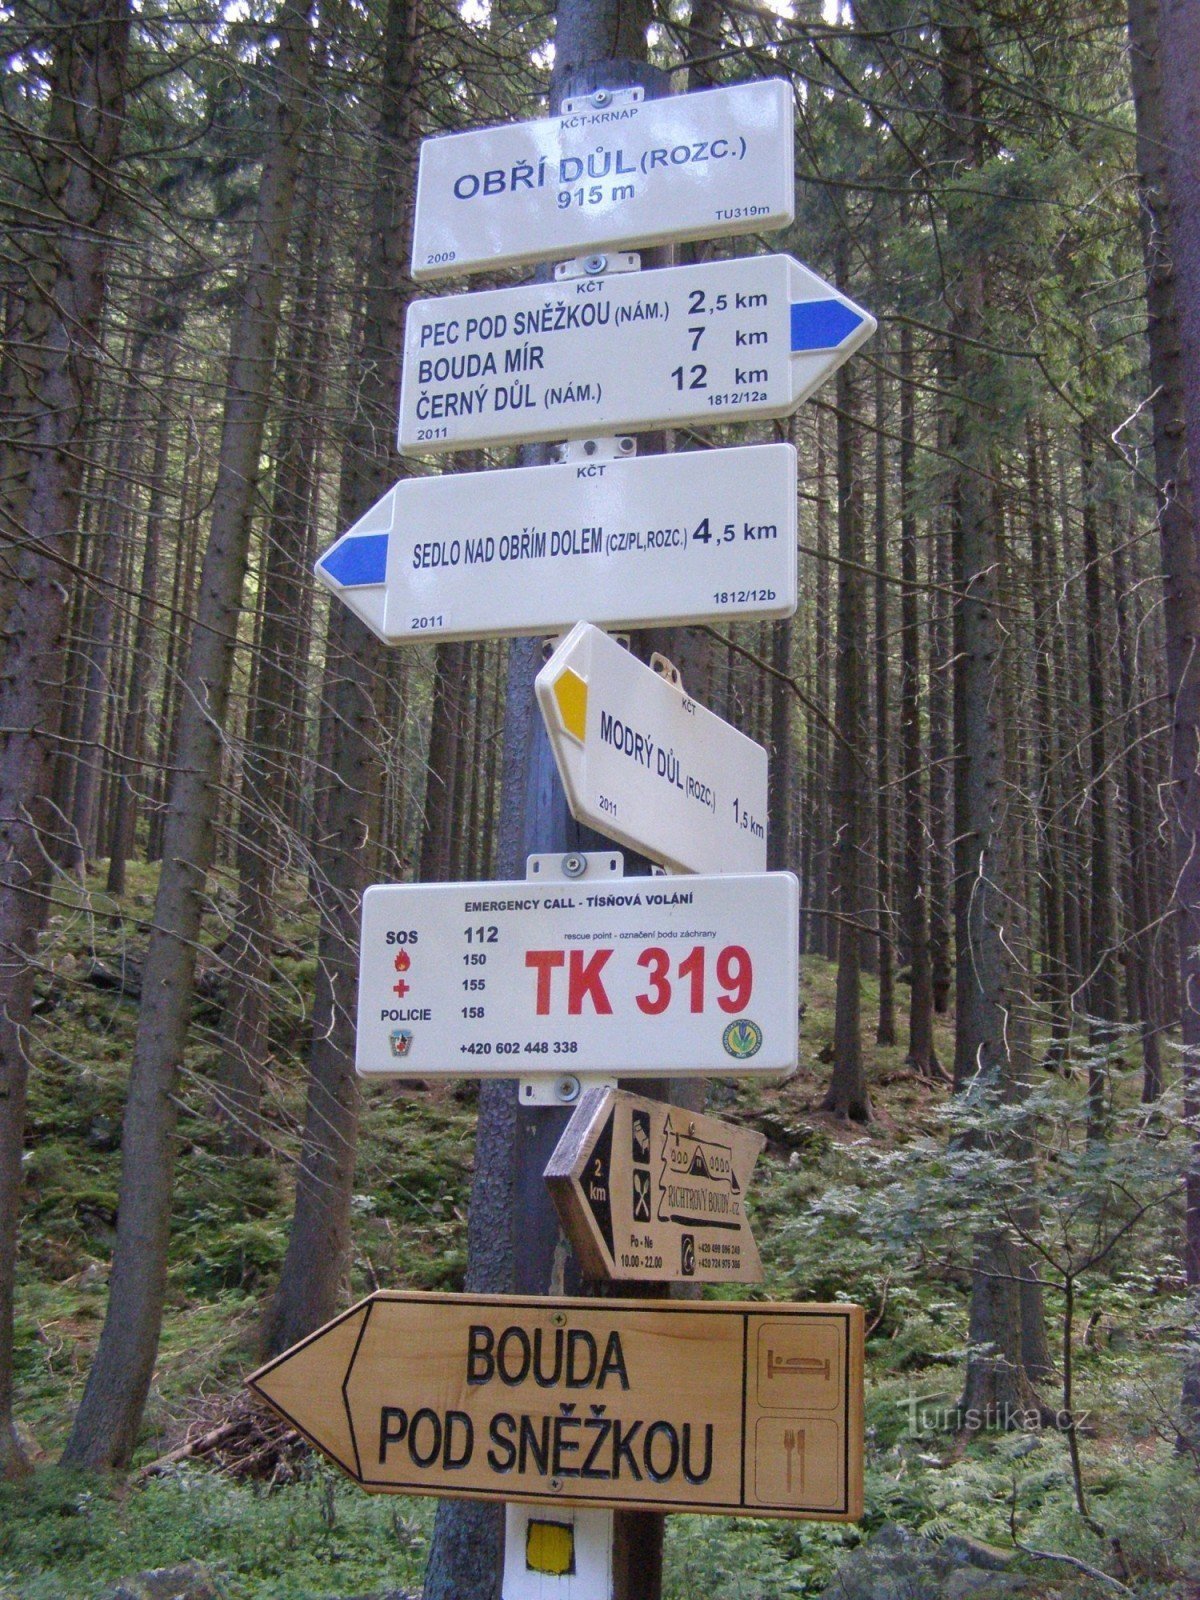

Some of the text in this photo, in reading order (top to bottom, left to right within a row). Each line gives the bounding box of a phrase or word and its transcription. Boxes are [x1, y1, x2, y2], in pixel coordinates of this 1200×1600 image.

[560, 108, 638, 129] KČT-KRNAP
[453, 136, 747, 200] OBŘÍ DŮL (ROZC.)
[557, 182, 635, 210] 915 m
[715, 205, 770, 221] TU319m
[427, 251, 456, 264] 2009
[576, 281, 604, 294] KČT
[420, 290, 768, 348] PEC POD SNĚŽKOU (NÁM.) 2,5 km
[419, 327, 768, 384] BOUDA MÍR 7 km
[416, 365, 768, 420] ČERNÝ DŮL (NÁM.) 12 km
[707, 390, 768, 407] 1812/12a
[417, 427, 448, 440] 2011
[576, 464, 606, 478] KČT
[412, 518, 777, 570] SEDLO NAD OBŘÍM DOLEM (CZ/PL,ROZC.) 4,5 km
[713, 589, 776, 604] 1812/12b
[411, 615, 444, 629] 2011
[682, 699, 696, 716] KČT
[601, 711, 764, 839] MODRÝ DŮL (ROZC.) 1,5 km
[599, 795, 617, 817] 2011
[464, 899, 540, 913] EMERGENCY
[543, 898, 575, 910] CALL
[586, 893, 642, 909] TÍSŇOVÁ
[645, 892, 693, 906] VOLÁNÍ
[385, 926, 499, 945] SOS 112
[592, 931, 612, 941] point
[619, 930, 655, 940] označení
[657, 930, 678, 939] bodu
[680, 929, 717, 941] záchrany
[463, 953, 487, 966] 150
[462, 979, 486, 991] 155
[525, 945, 754, 1016] TK 319
[380, 1007, 485, 1022] POLICIE 158
[459, 1040, 578, 1055] +420 602 448 338
[594, 1159, 602, 1177] 2
[590, 1182, 606, 1201] km
[630, 1235, 640, 1247] Po
[644, 1235, 653, 1249] Ne
[621, 1256, 640, 1268] 10.00
[645, 1256, 663, 1269] 22.00
[466, 1325, 630, 1391] BOUDA
[379, 1403, 714, 1486] POD SNĚŽKOU
